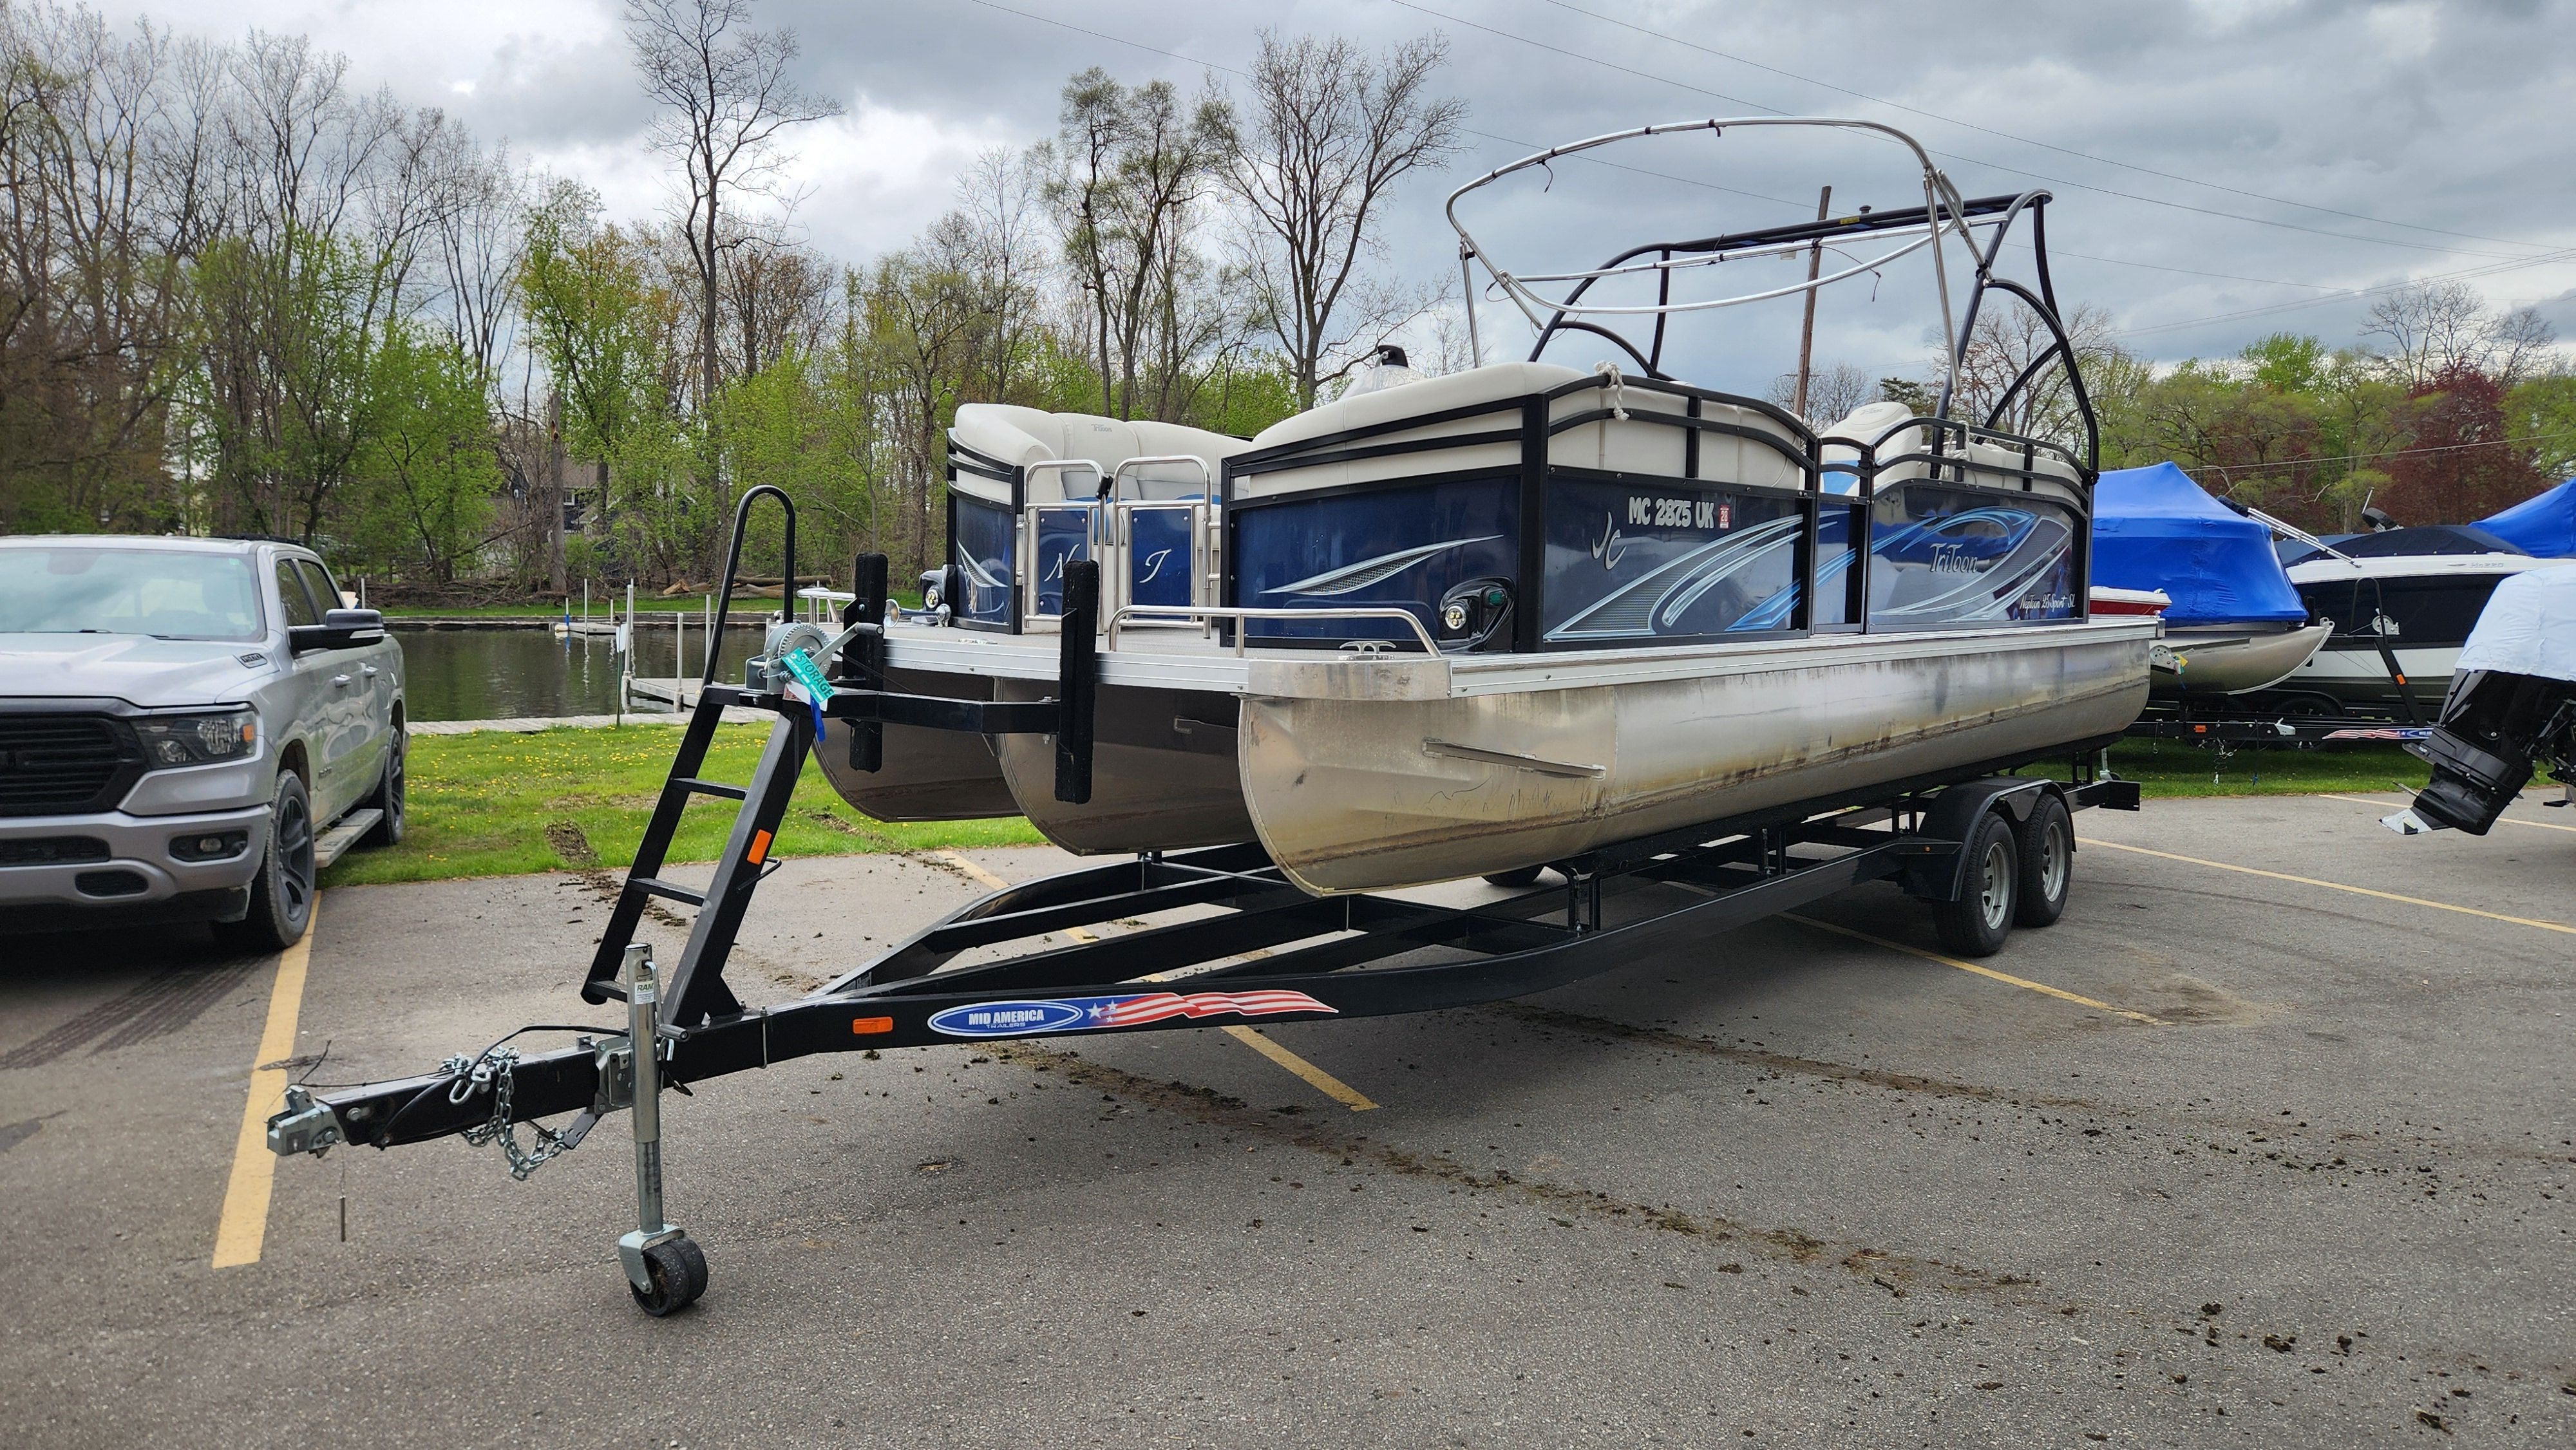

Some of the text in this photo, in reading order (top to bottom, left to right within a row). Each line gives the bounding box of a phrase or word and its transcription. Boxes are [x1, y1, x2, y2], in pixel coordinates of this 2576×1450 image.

[1628, 496, 1714, 529] MC 2875 UK
[1929, 542, 1978, 573] TriToon
[2041, 593, 2050, 608] 25
[2050, 594, 2068, 613] Sport
[795, 655, 834, 697] STORAGE
[968, 1009, 1045, 1025] MID AMERICA
